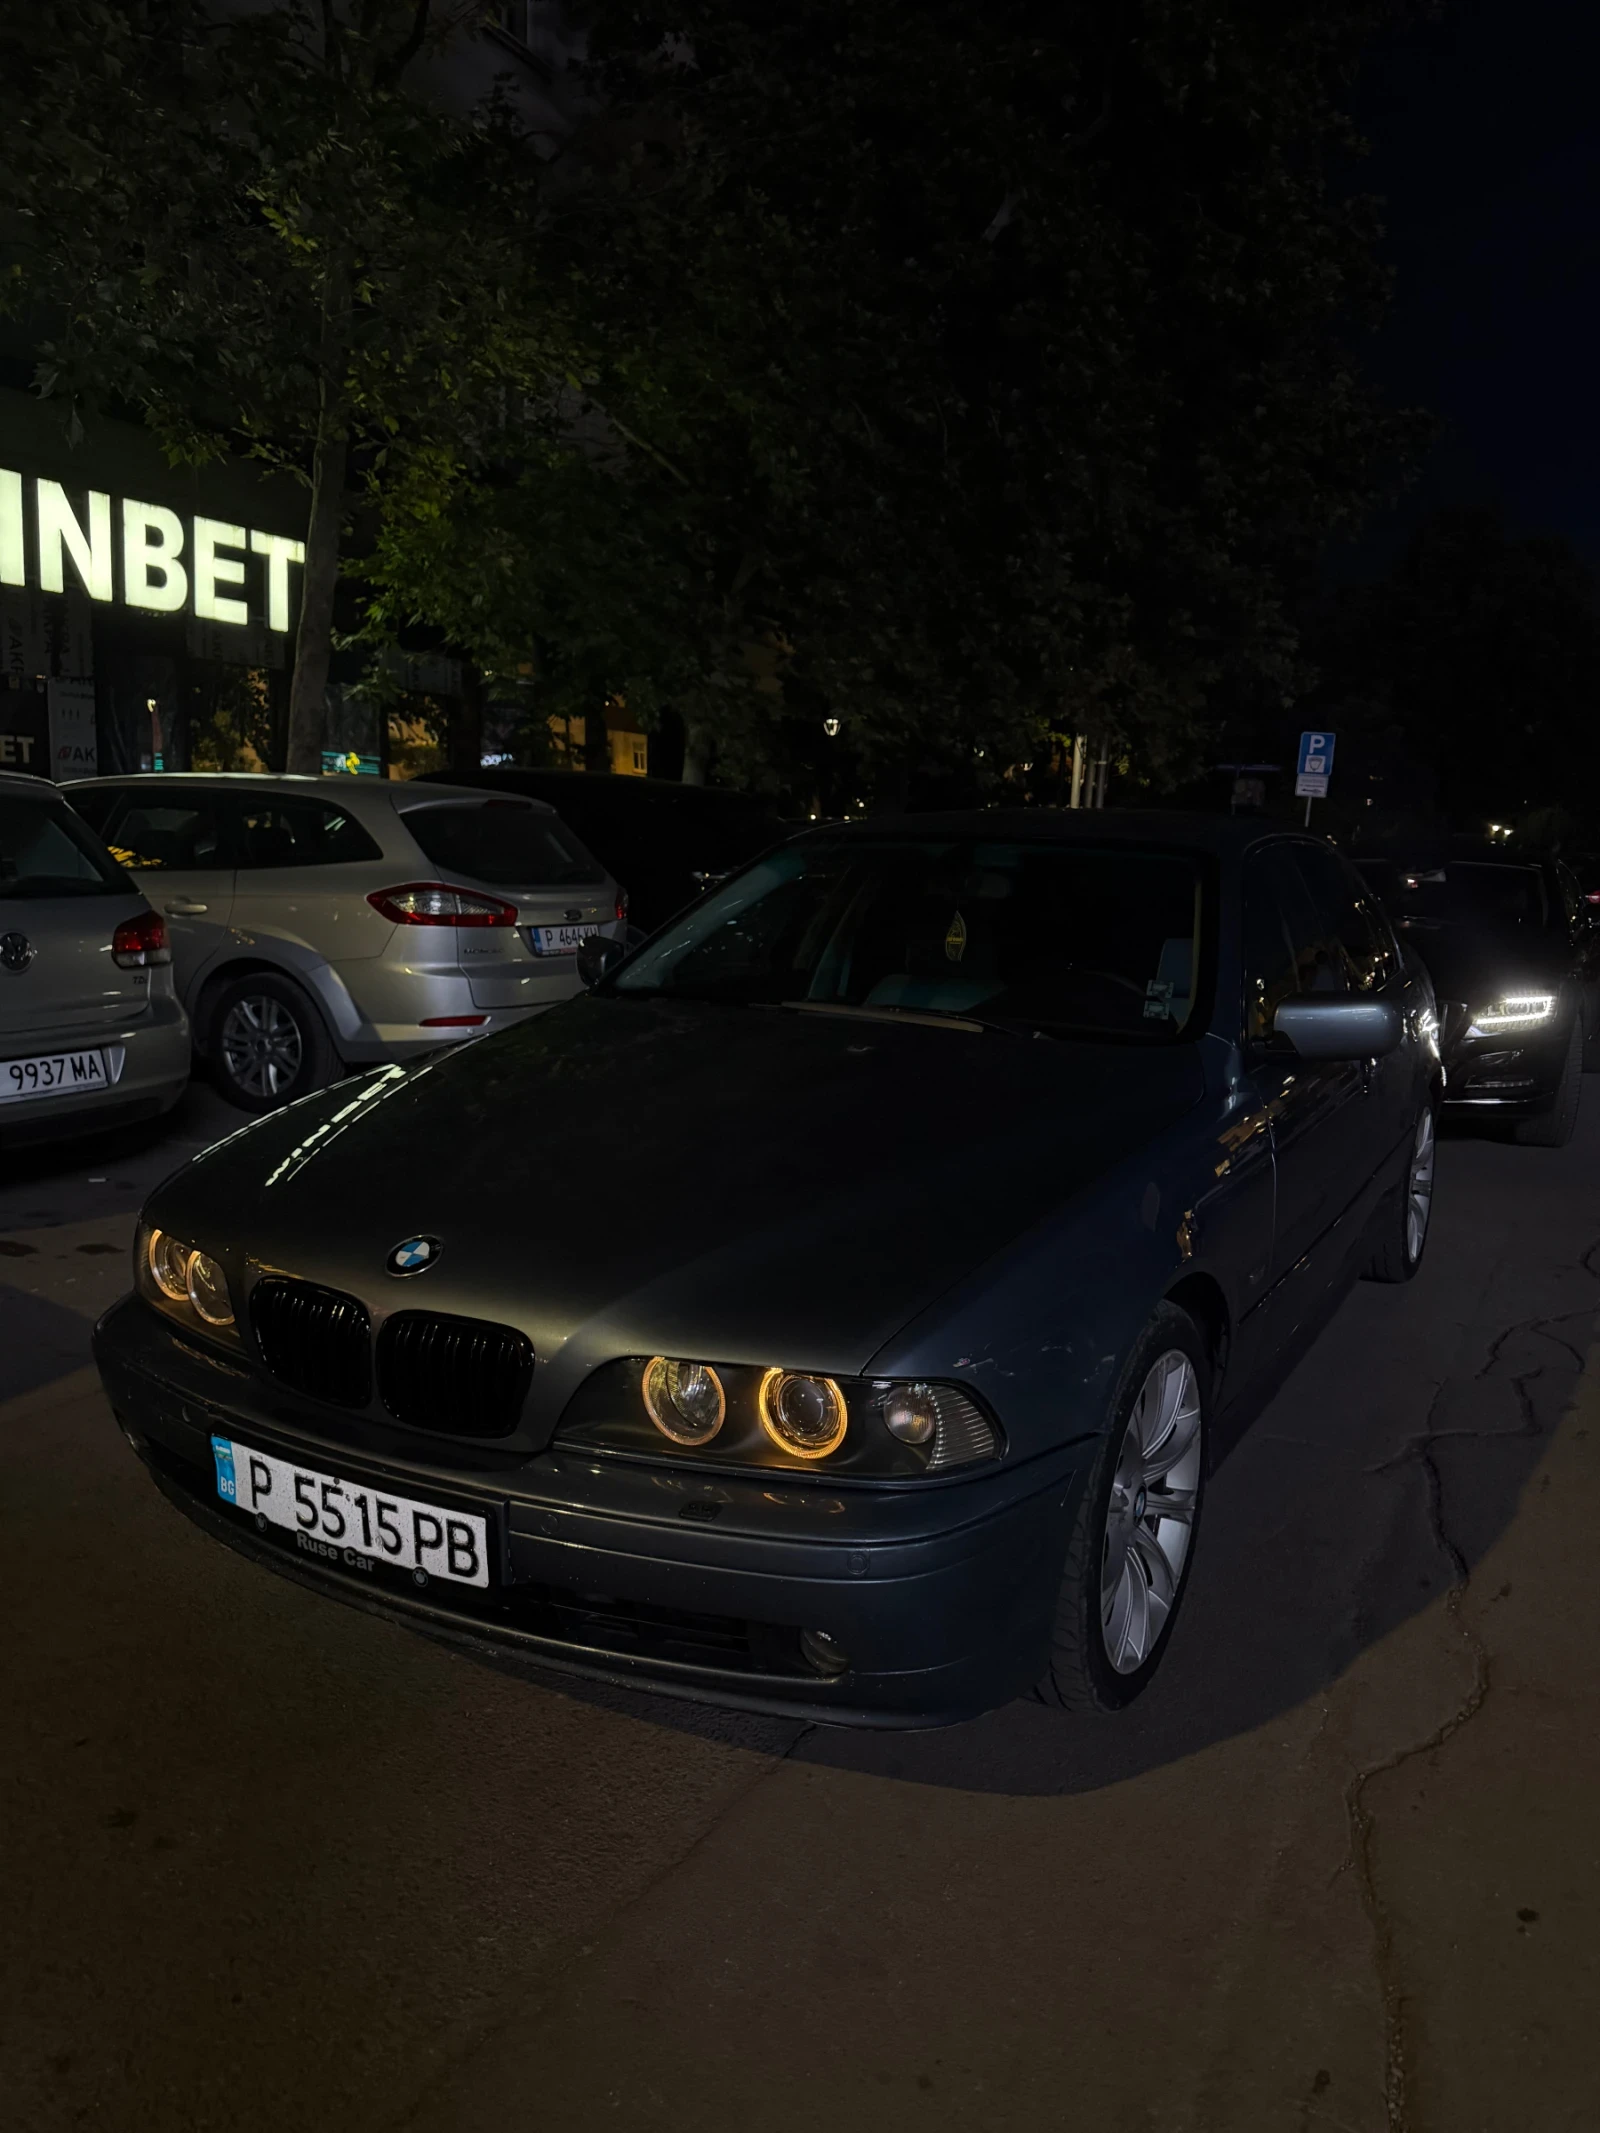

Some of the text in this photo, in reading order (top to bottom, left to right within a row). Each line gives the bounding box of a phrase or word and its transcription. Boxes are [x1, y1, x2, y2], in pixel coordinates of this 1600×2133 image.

[1309, 734, 1326, 754] P
[545, 929, 553, 947] P
[9, 1054, 101, 1090] 9937 MA
[220, 1476, 235, 1496] BG
[249, 1456, 479, 1578] P 5515 PB
[296, 1530, 376, 1573] Ruse Car
